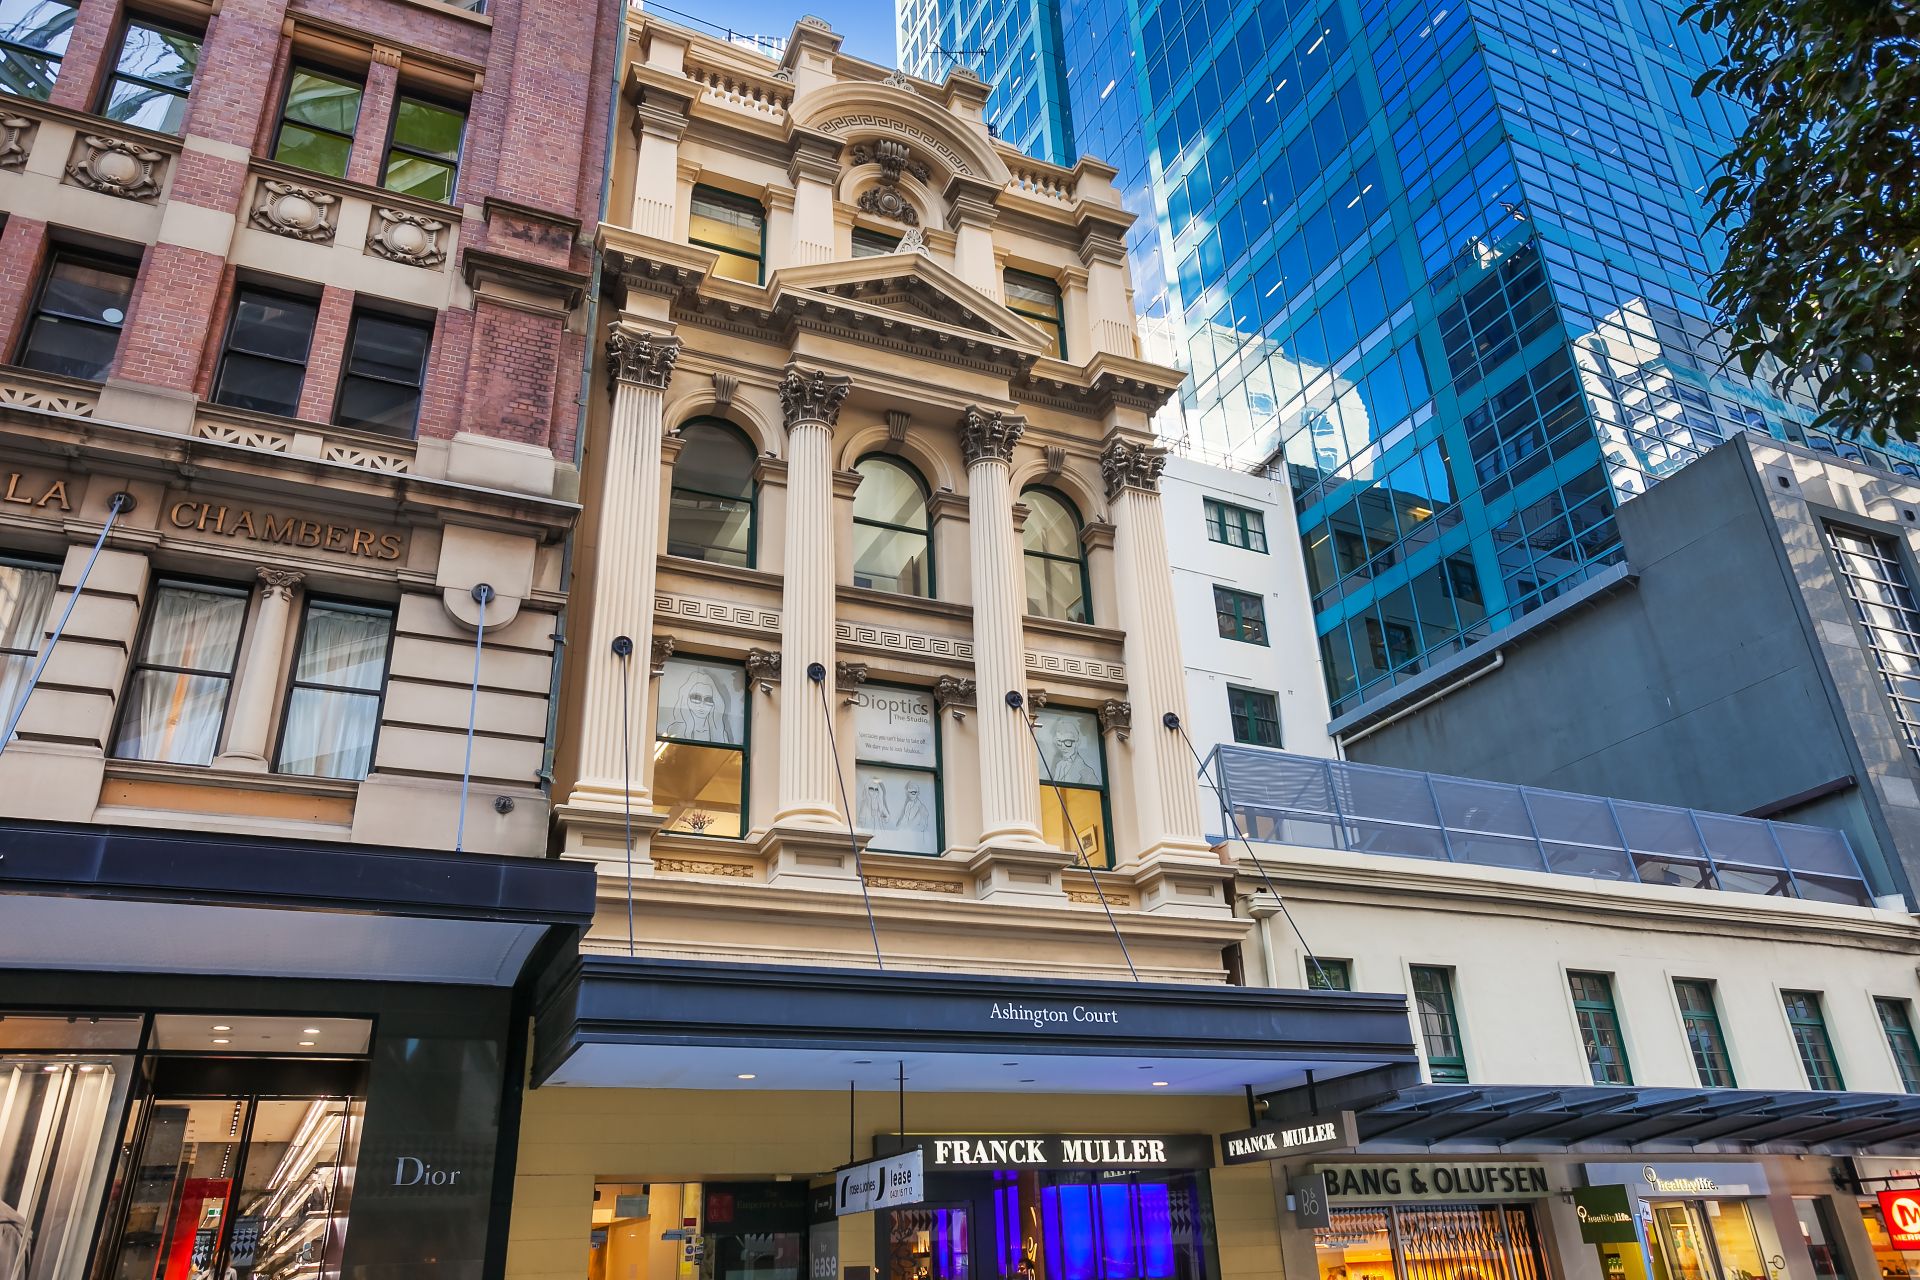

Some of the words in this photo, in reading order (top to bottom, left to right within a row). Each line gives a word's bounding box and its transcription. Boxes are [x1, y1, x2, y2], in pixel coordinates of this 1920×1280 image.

[3, 472, 72, 511] LA
[170, 501, 402, 561] CHAMBERS
[858, 693, 928, 725] Dioptics
[907, 715, 928, 724] Studio
[990, 1002, 1069, 1028] Ashington
[1072, 1005, 1119, 1024] Court
[934, 1139, 1048, 1165] FRANCK
[1060, 1139, 1168, 1163] MULLER
[1228, 1132, 1278, 1156] FRANCK
[1281, 1122, 1337, 1148] MULLER
[391, 1156, 461, 1186] Dior
[891, 1169, 912, 1187] lease
[1323, 1168, 1402, 1195] BANG
[1411, 1168, 1429, 1195] &
[1433, 1167, 1549, 1194] OLUFSEN
[849, 1184, 859, 1195] rose
[811, 1253, 837, 1278] lease
